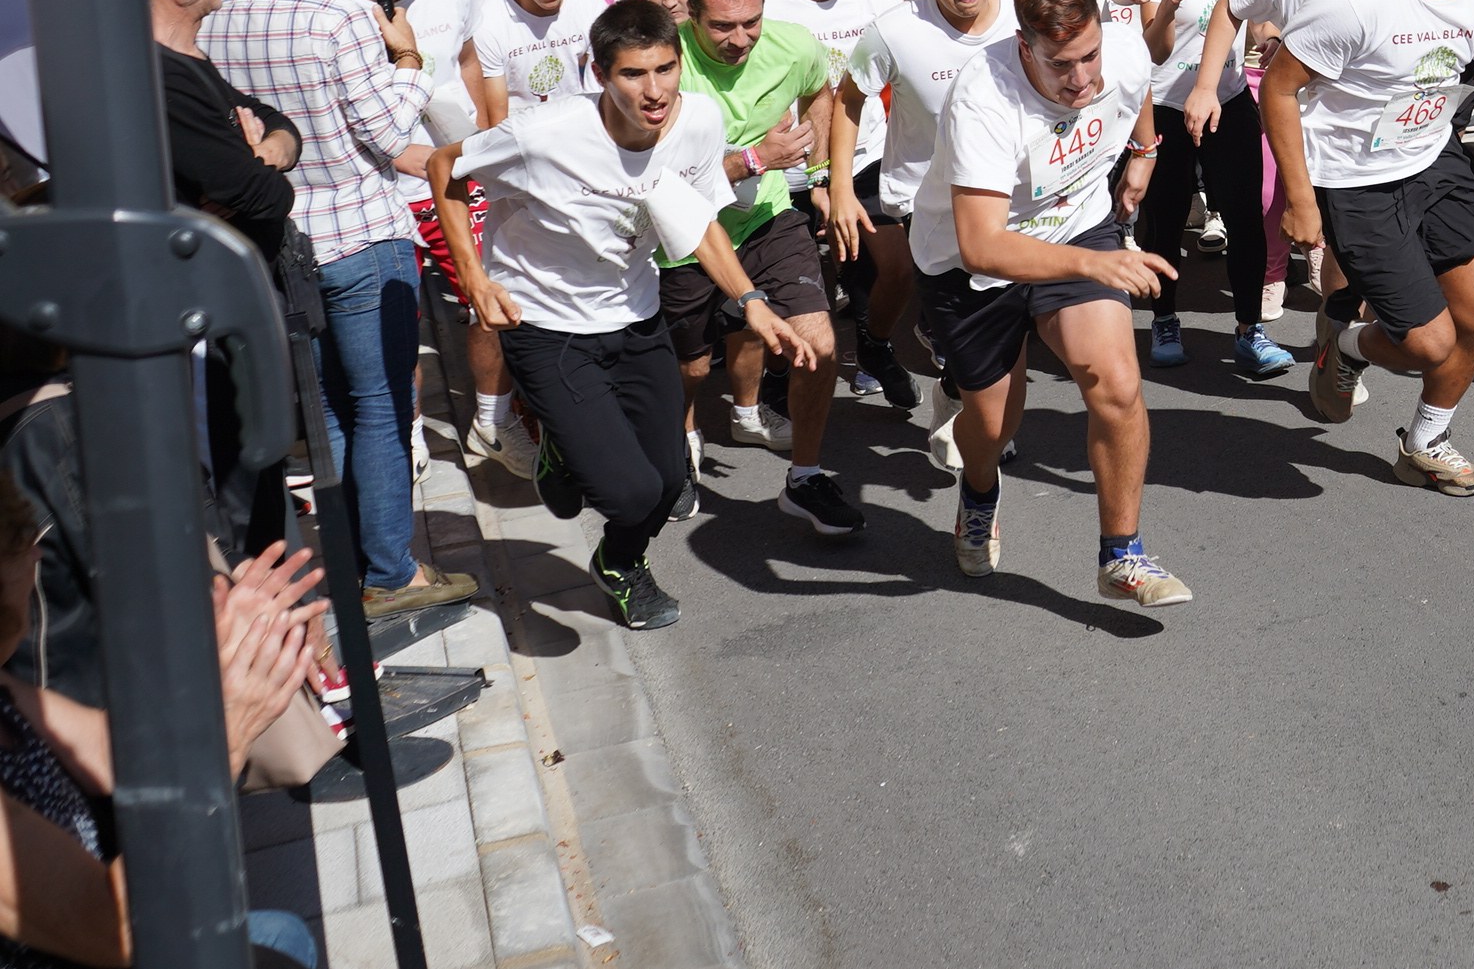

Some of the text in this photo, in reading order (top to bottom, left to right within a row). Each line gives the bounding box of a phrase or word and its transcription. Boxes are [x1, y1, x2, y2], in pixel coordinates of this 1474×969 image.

[417, 22, 452, 40] LANCA
[832, 28, 865, 40] BLANC
[1392, 33, 1413, 45] CEE
[1417, 31, 1441, 42] VAL
[931, 69, 954, 81] CEE
[1395, 95, 1447, 127] 468
[1048, 118, 1104, 166] 449
